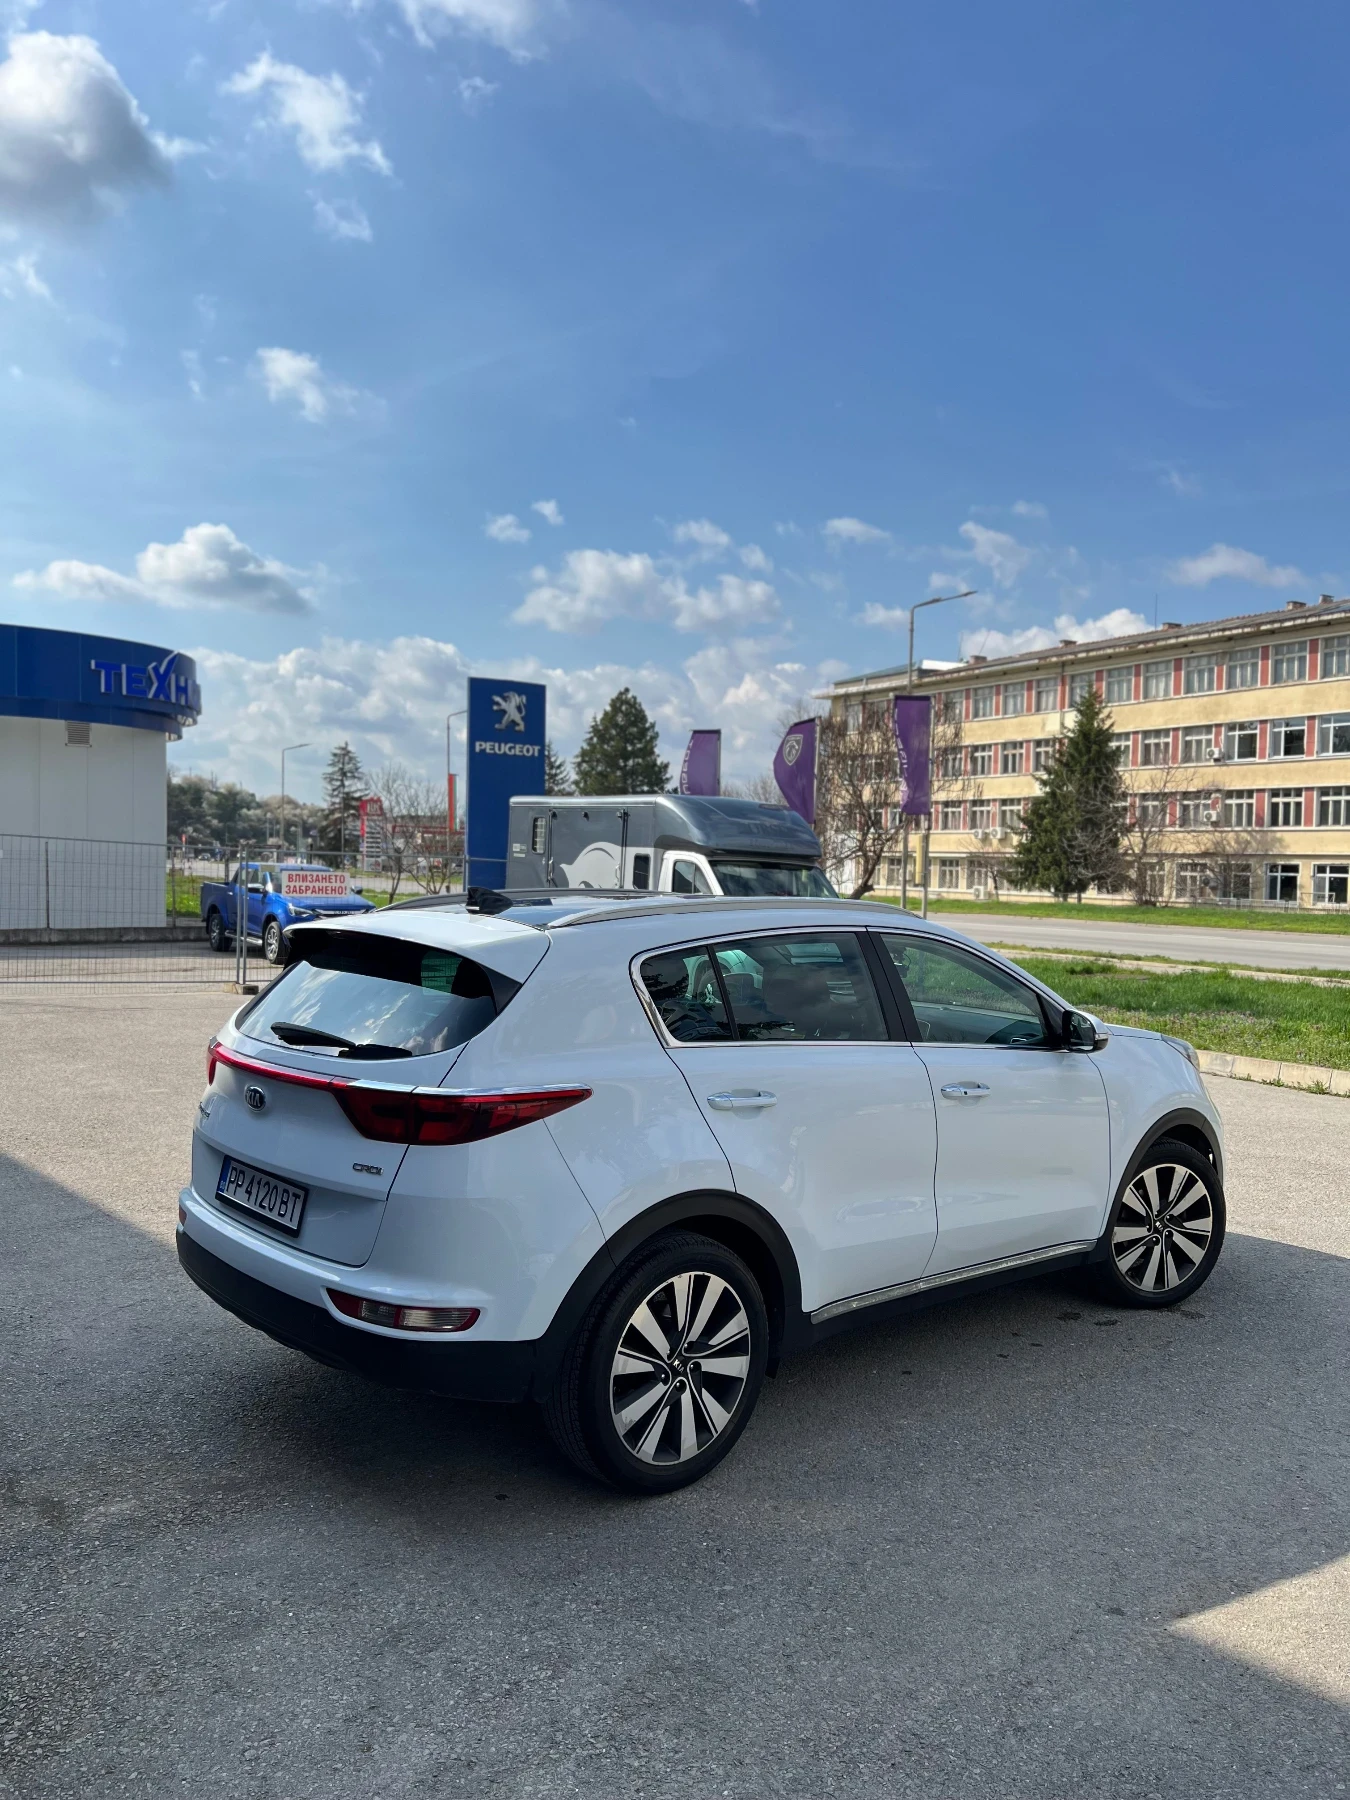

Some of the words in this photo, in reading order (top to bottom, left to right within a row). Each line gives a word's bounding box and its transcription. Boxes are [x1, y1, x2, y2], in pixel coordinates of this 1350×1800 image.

[91, 650, 201, 714] ТЕХН
[475, 741, 540, 757] PEUGEOT
[287, 873, 346, 884] ВЛИЗАНЕТО
[285, 885, 347, 895] ЗАБРАНЕНО!
[246, 1091, 261, 1107] KIA
[673, 1359, 685, 1373] KIA
